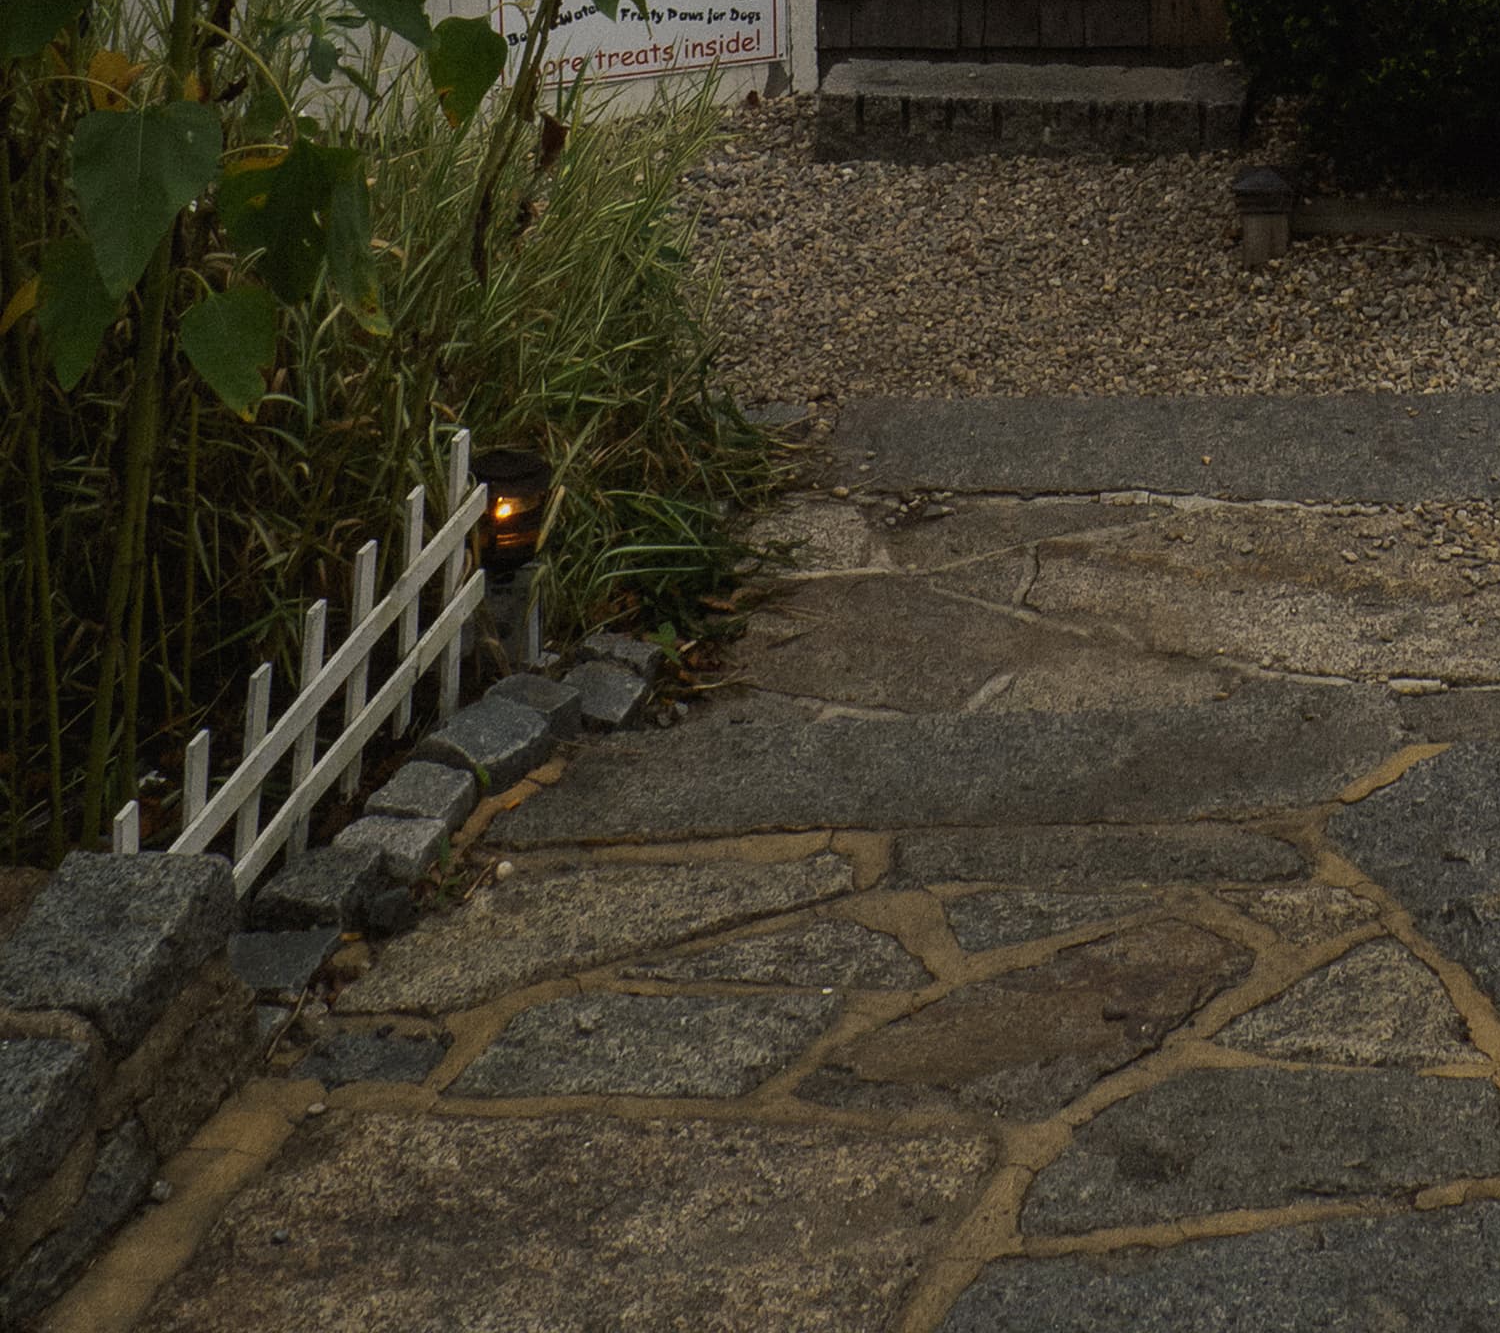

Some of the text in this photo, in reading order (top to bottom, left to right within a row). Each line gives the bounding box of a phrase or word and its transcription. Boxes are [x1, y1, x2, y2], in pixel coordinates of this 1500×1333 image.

[667, 8, 703, 21] Paws
[706, 7, 726, 24] for
[730, 8, 761, 24] Dogs
[594, 44, 674, 69] treats
[685, 29, 760, 59] inside!
